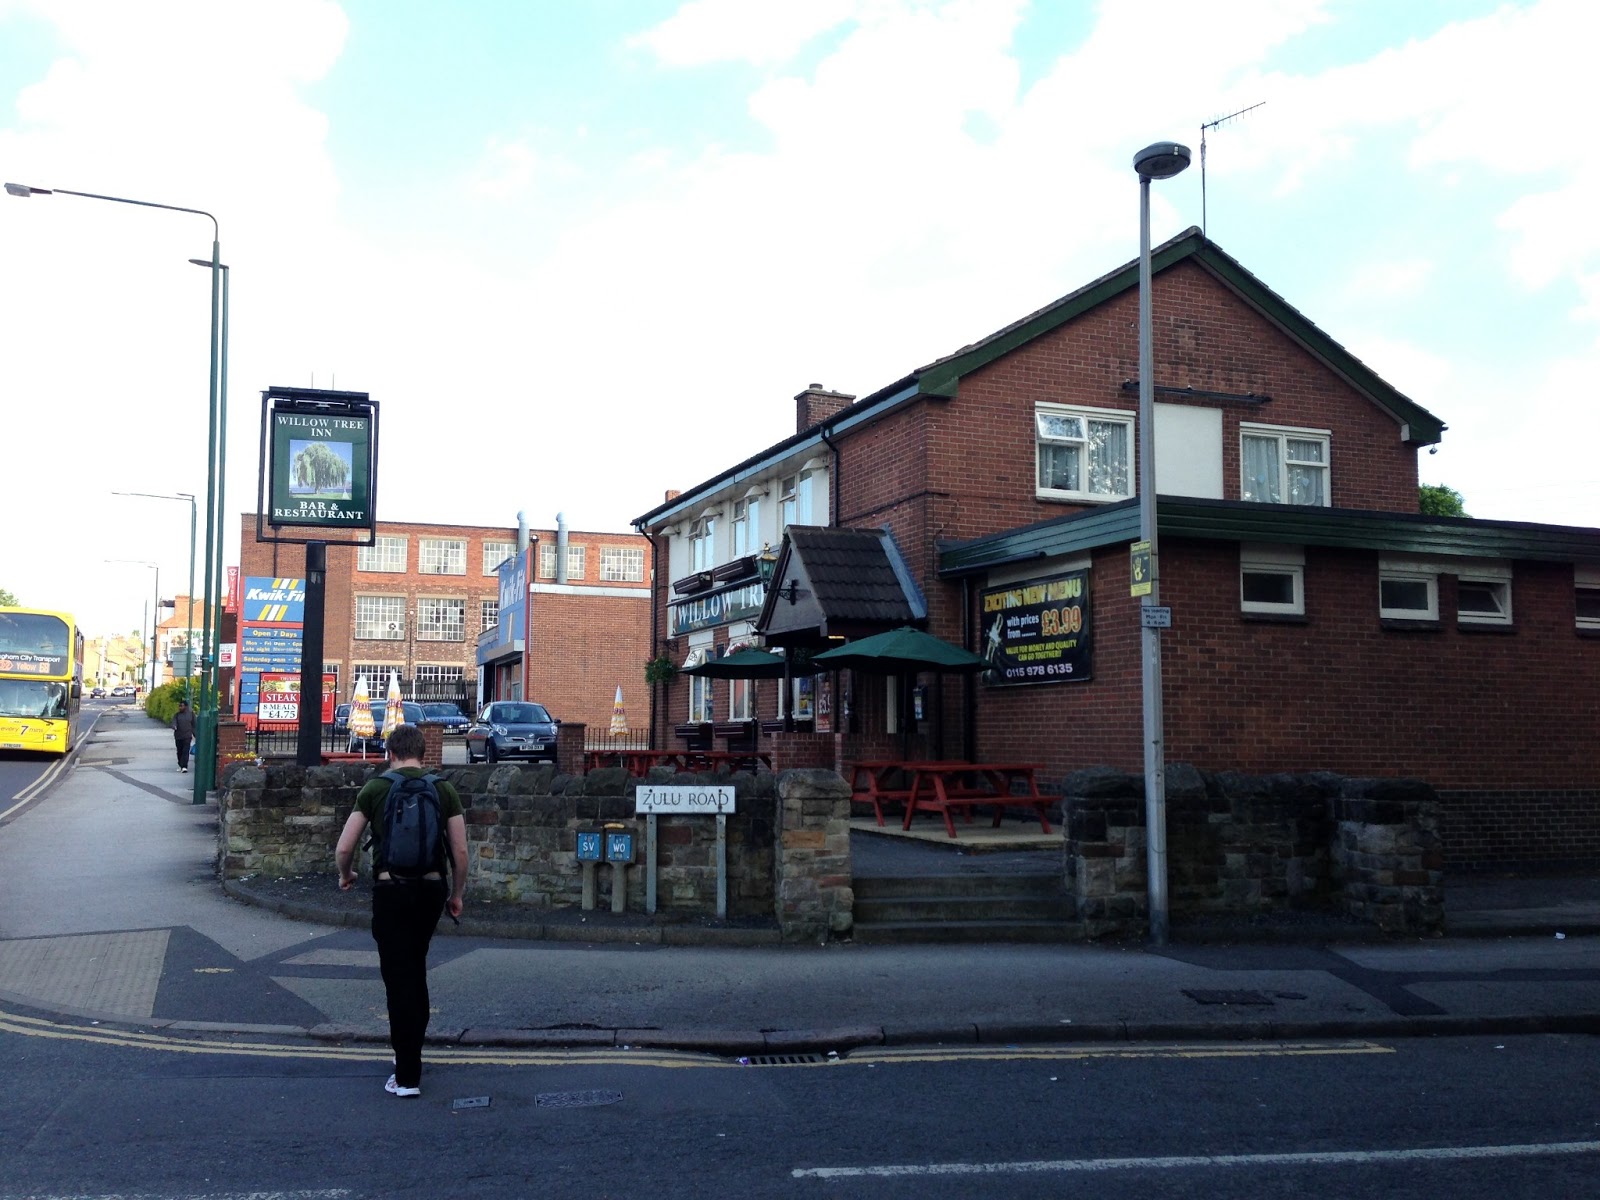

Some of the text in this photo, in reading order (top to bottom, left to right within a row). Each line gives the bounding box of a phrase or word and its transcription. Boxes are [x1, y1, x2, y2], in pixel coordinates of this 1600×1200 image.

[278, 416, 364, 430] WILLOW TREE
[311, 428, 332, 437] INN
[300, 501, 326, 510] BAR
[274, 509, 364, 520] RESTAURANT
[984, 578, 1082, 613] EXCITING NEW MENU
[677, 591, 733, 626] WILLOW
[1006, 605, 1082, 637] with prices £3.99
[1006, 663, 1073, 678] 0115 978 6135
[266, 694, 297, 702] STEAK
[21, 726, 29, 735] 7
[642, 792, 729, 806] ZULU ROAD
[583, 842, 594, 851] SV
[613, 843, 625, 852] WO
